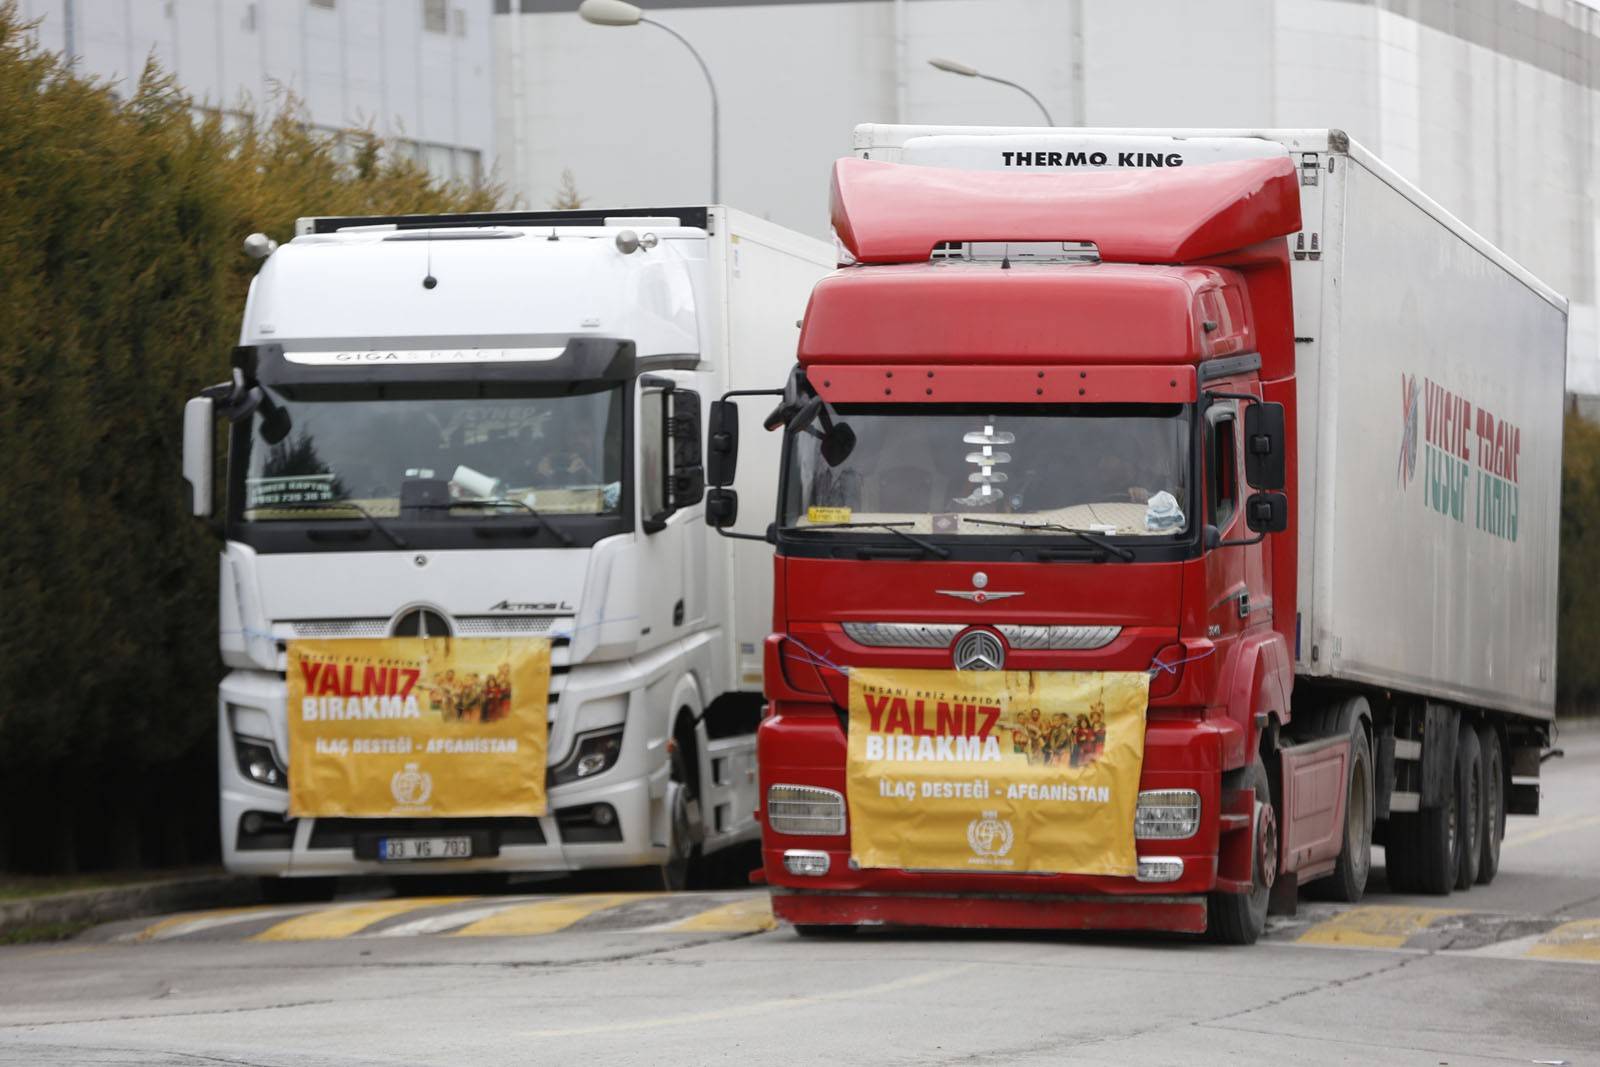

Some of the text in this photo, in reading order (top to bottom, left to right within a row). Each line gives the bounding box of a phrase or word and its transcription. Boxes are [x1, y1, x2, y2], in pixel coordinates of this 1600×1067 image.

[1002, 152, 1183, 168] THERMO KING
[300, 661, 420, 702] YALNIZ
[302, 695, 420, 721] BIRAKMA
[953, 694, 1001, 705] KAPIDA
[864, 694, 1001, 743] YALNIZ
[316, 737, 348, 757] İLAÇ
[426, 737, 518, 753] AFGANİSTAN
[866, 735, 1001, 761] BIRAKMA
[879, 779, 916, 800] İLAÇ
[921, 779, 989, 799] DESTEĞİ
[1007, 783, 1110, 803] AFGANİSTAN
